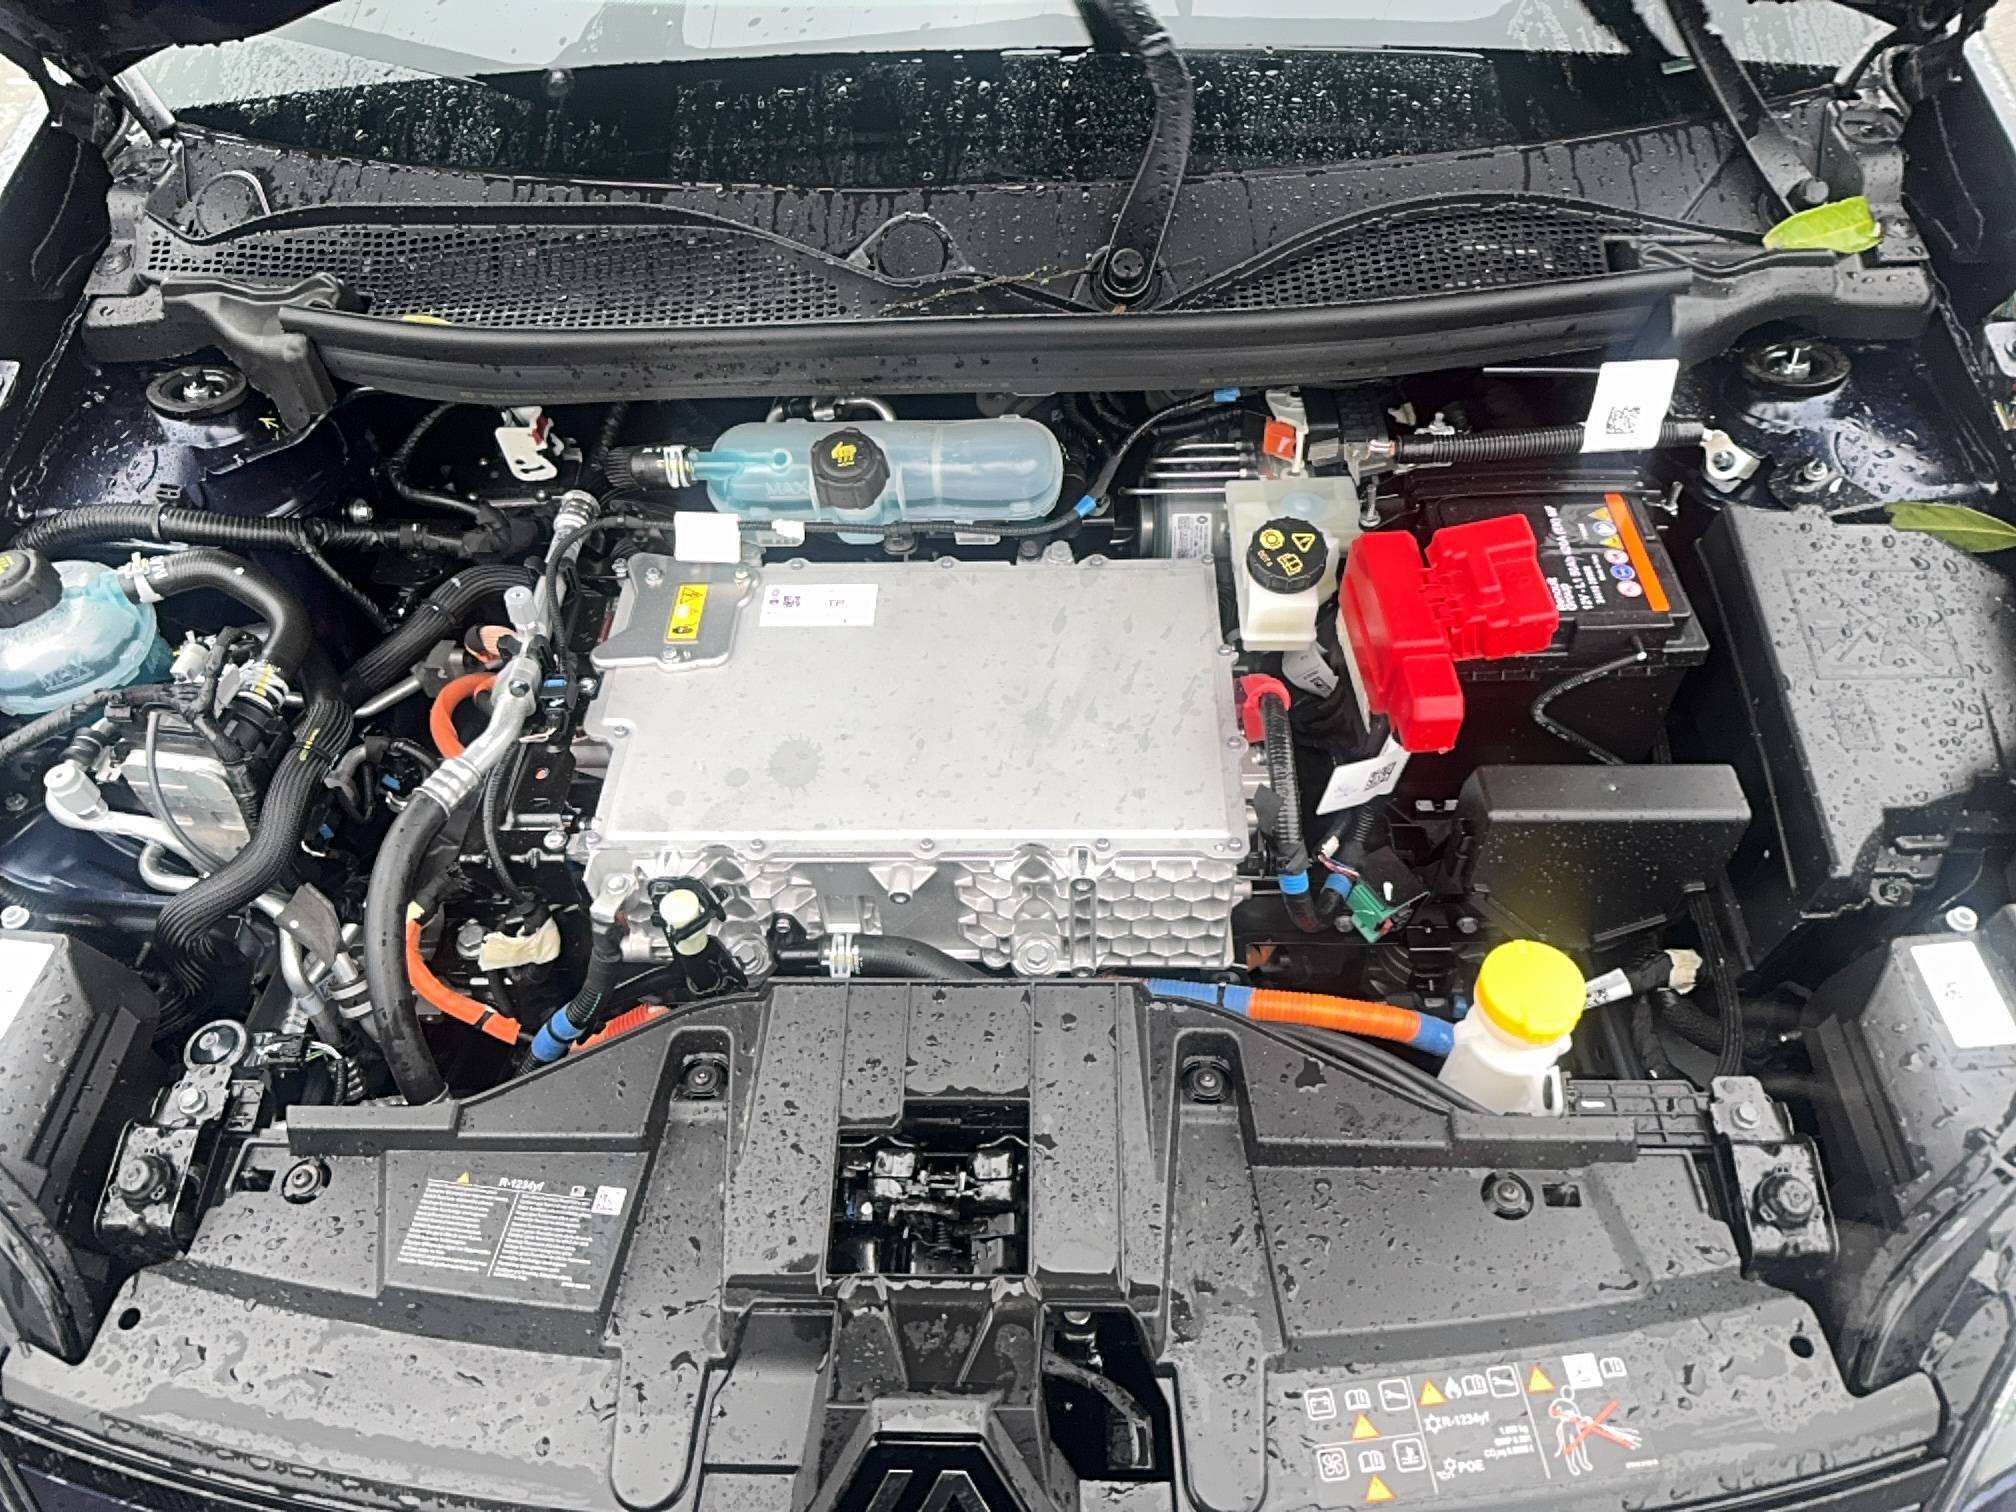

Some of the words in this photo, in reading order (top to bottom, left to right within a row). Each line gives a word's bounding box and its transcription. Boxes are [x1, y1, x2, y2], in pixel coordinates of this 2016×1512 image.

[766, 480, 808, 497] MAX
[498, 1177, 545, 1192] R-1234yf
[1441, 1411, 1490, 1427] R-1234yf
[1457, 1459, 1486, 1474] POE
